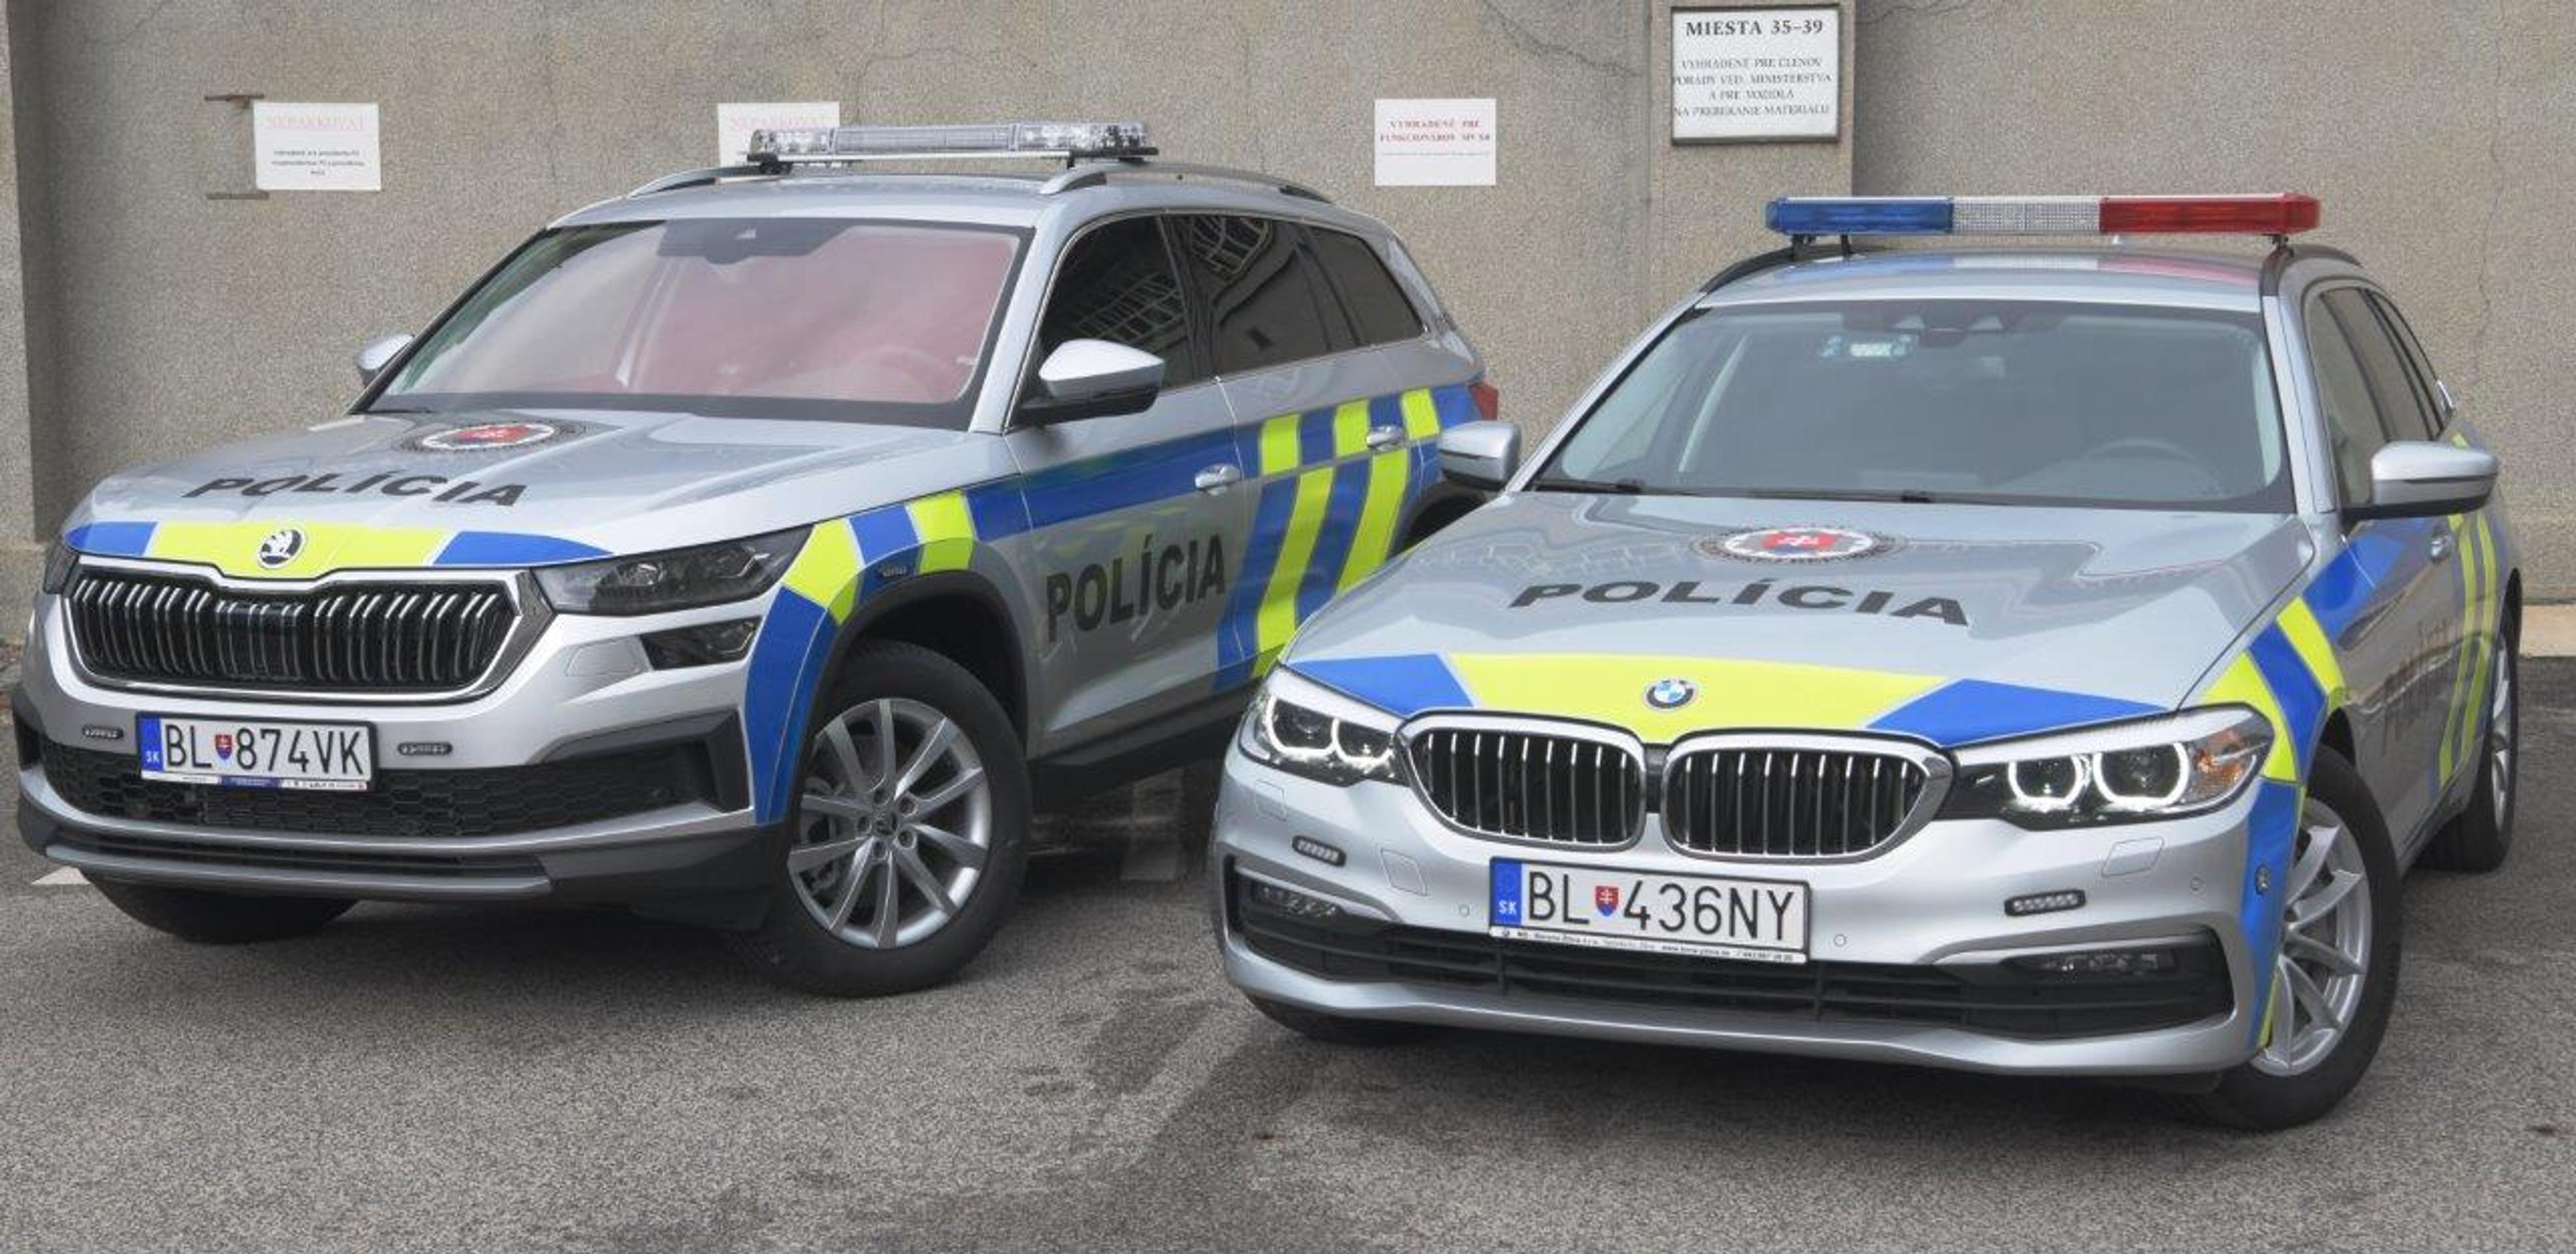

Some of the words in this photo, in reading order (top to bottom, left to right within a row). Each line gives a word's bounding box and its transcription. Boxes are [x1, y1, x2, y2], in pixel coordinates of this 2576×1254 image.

[1686, 20, 1762, 36] MIESTA
[1749, 72, 1832, 84] MINISTERSTVA
[1755, 57, 1775, 67] PRE
[1720, 90, 1739, 100] PRE
[182, 470, 528, 507] POLÍCIA
[1046, 533, 1226, 643] POLÍCIA
[1508, 578, 1969, 626] POLÍCIA
[145, 750, 161, 764] SK
[165, 724, 212, 768] BL
[236, 728, 364, 775] 874VK
[1499, 901, 1517, 914] SK
[1529, 871, 1590, 925] BL
[1623, 880, 1795, 941] 436NY
